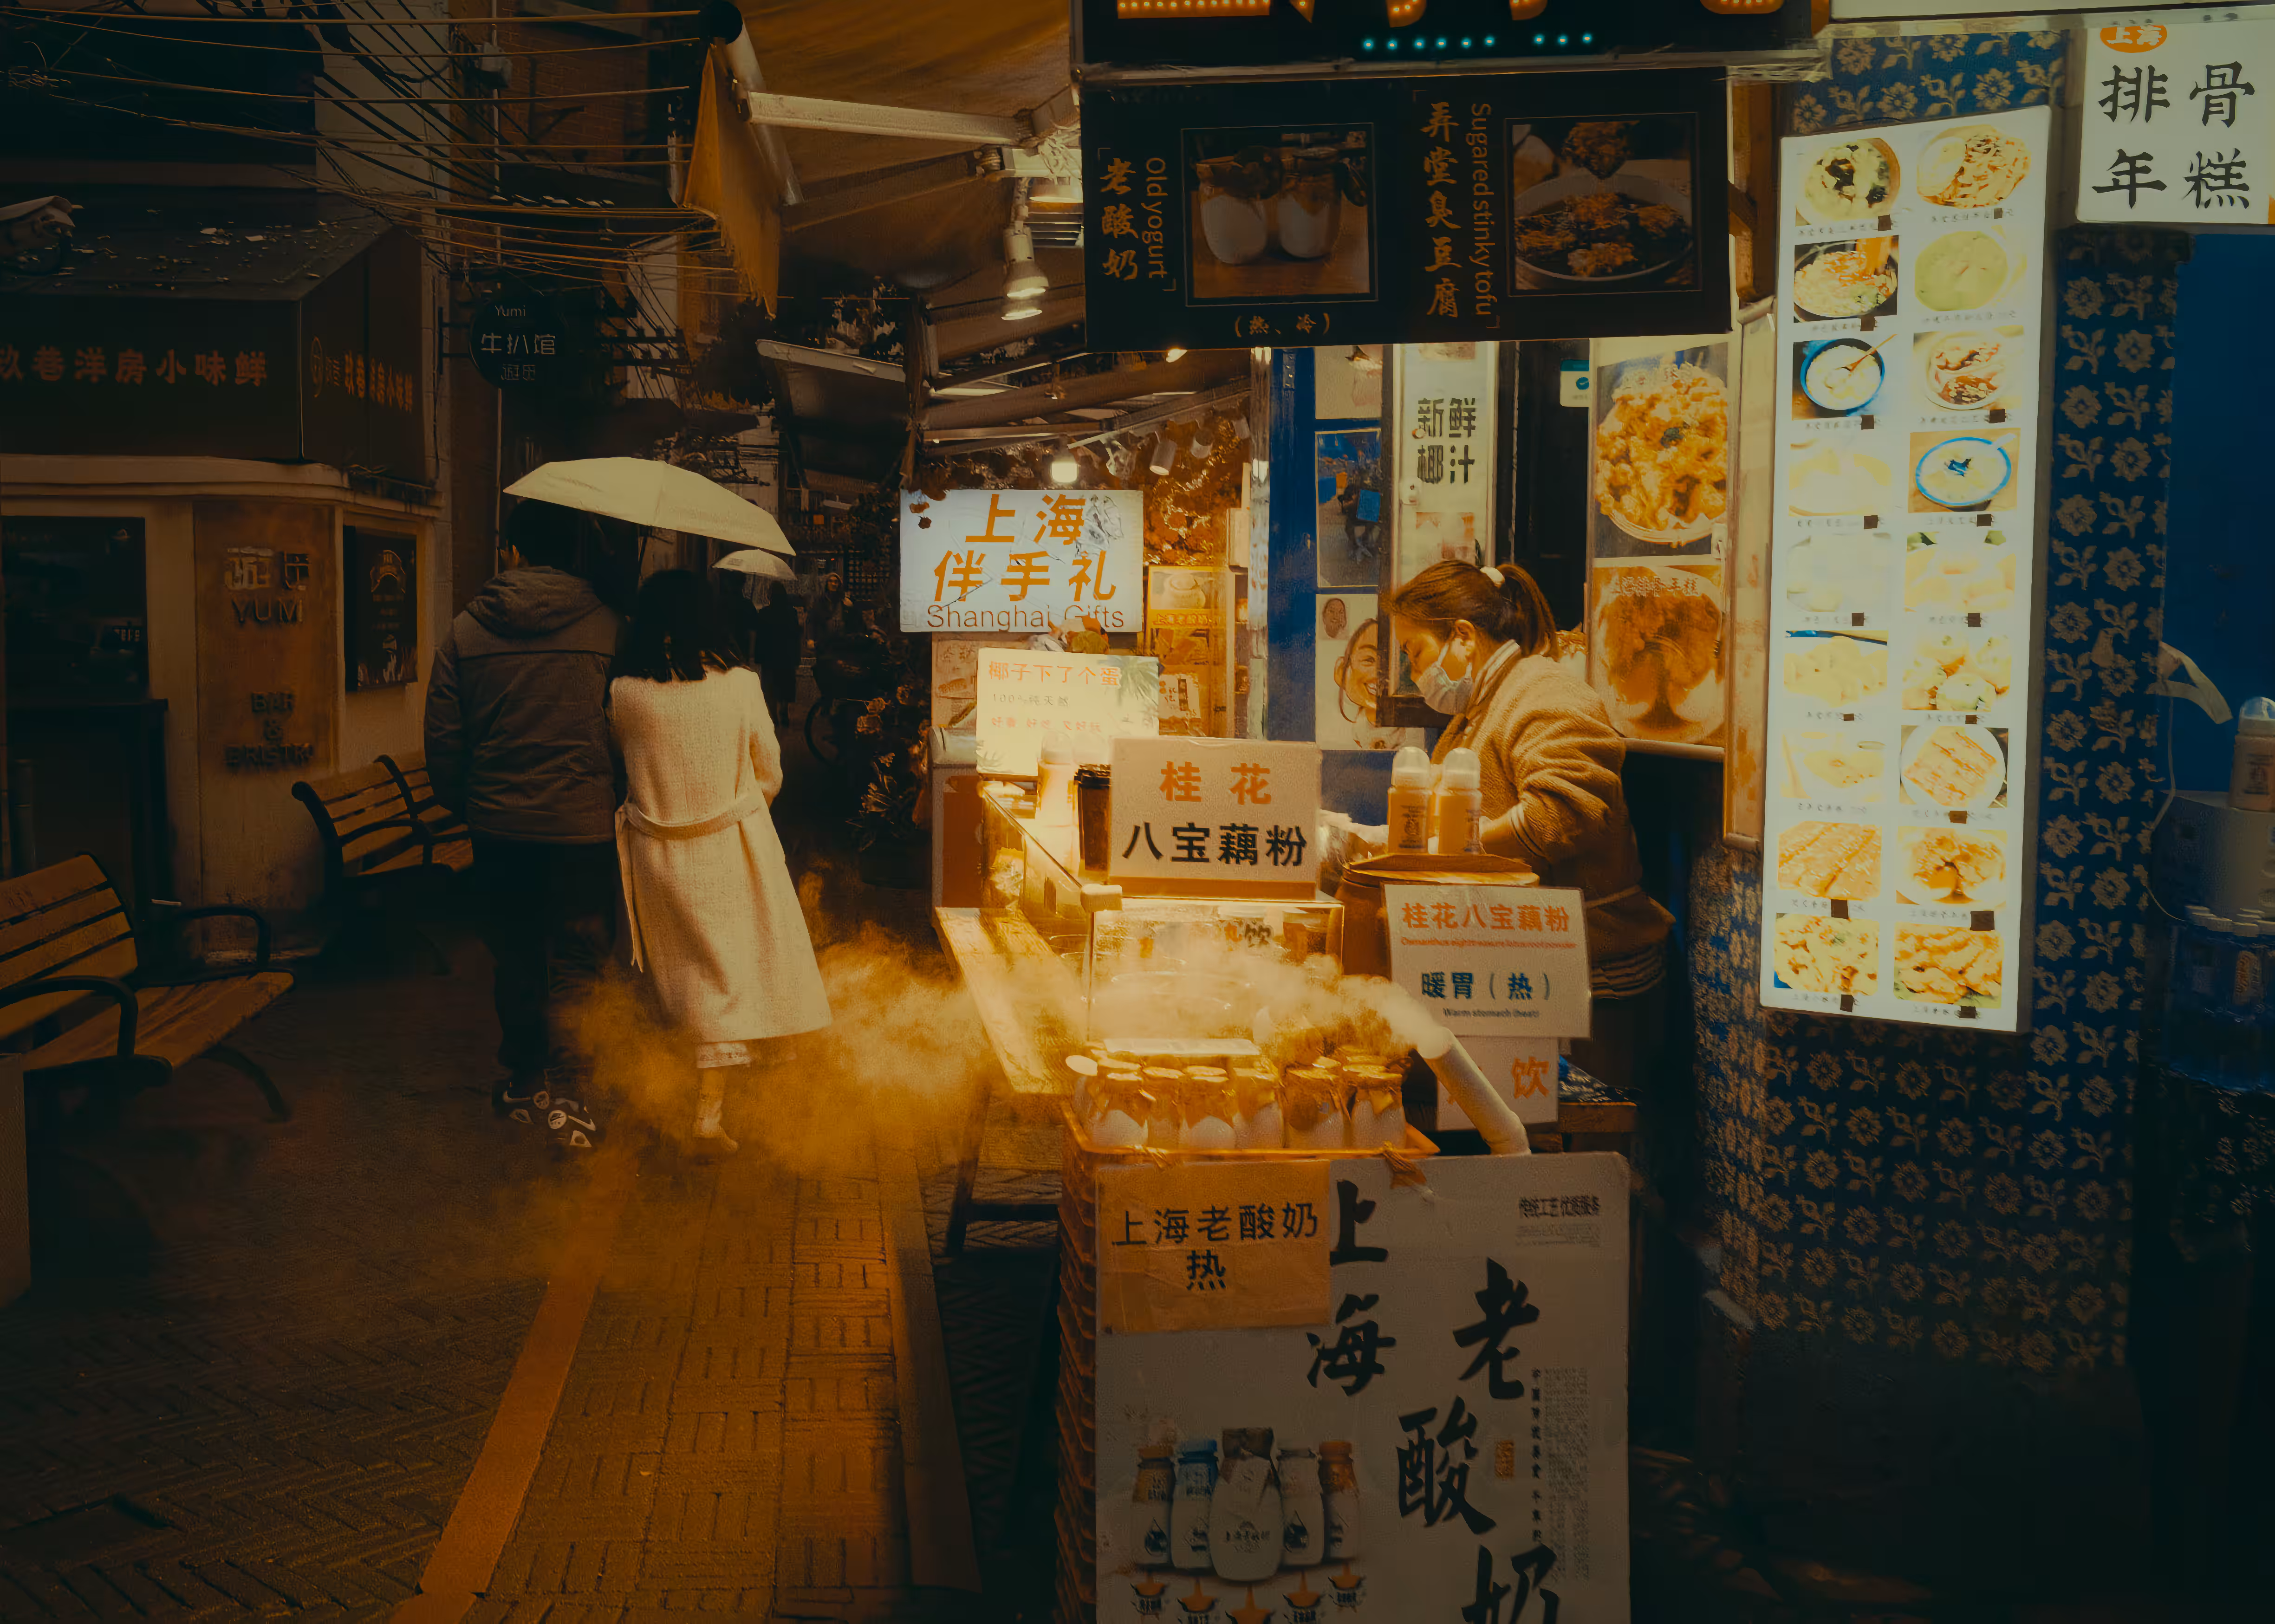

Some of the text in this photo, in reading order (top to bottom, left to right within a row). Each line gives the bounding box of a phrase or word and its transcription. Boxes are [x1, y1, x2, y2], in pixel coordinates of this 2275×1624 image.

[2098, 61, 2255, 128] 排骨
[1466, 104, 1495, 195] Sugared
[2092, 148, 2250, 209] 年糕
[1100, 158, 1138, 280] 老酸奶
[1420, 102, 1462, 318] 弄堂臭豆腐
[494, 305, 526, 317] Yumi
[1475, 270, 1498, 315] tofu
[481, 332, 556, 355] 牛扒馆
[1417, 398, 1476, 437] 新鲜
[1417, 445, 1475, 484] 椰汁
[965, 494, 1086, 545] 上海
[934, 550, 1116, 602] 伴手礼
[927, 604, 1050, 632] Shanghai
[988, 661, 1120, 686] 椰子下了个蛋
[1160, 761, 1271, 805] 桂花
[1122, 822, 1306, 866] 八宝藕粉
[1402, 903, 1569, 932] 桂花八宝藕粉
[1112, 1202, 1318, 1246] 上海老酸奶
[1186, 1250, 1226, 1291] 热
